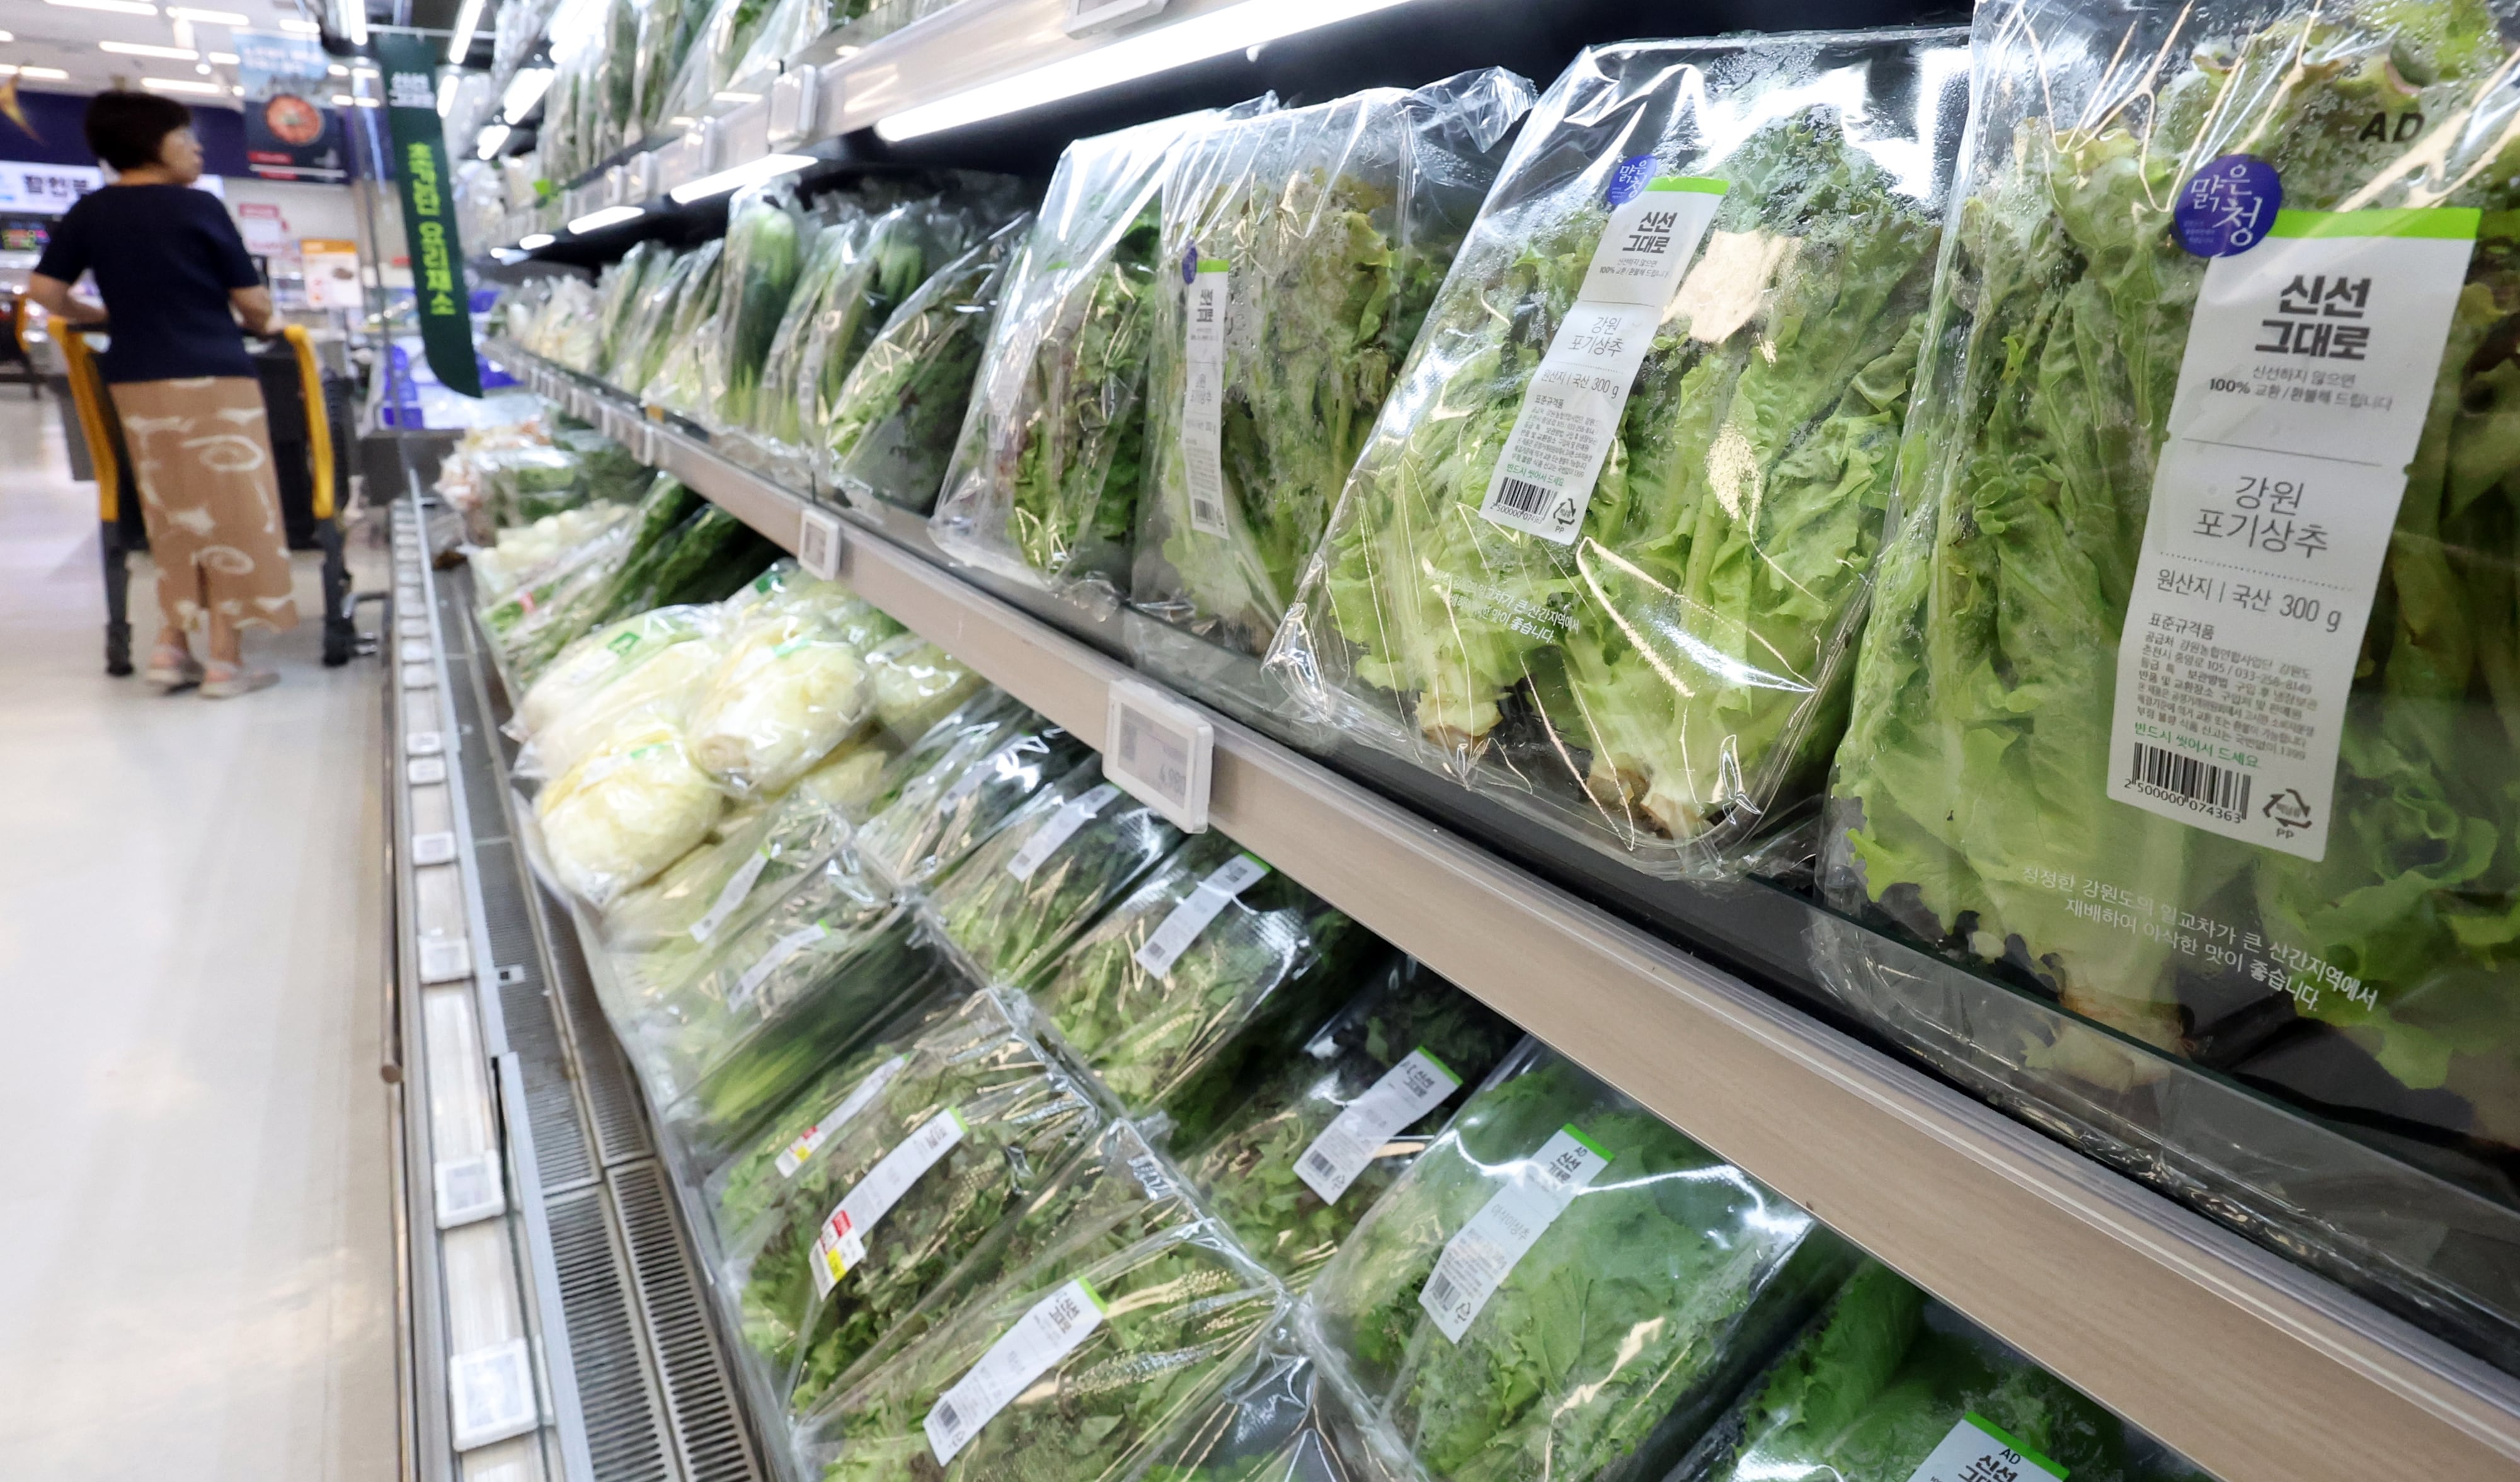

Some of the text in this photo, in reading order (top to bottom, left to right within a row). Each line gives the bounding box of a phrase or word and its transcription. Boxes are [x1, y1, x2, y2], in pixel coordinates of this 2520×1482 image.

[2359, 112, 2425, 142] AD
[2191, 164, 2253, 212] 맑은
[1637, 212, 1678, 233] 신선
[2213, 196, 2263, 247] 청
[1622, 234, 1671, 254] 그대로
[2278, 274, 2372, 319] 신선
[1591, 316, 1622, 335] 강원
[2254, 319, 2371, 361] 그대로
[1567, 335, 1624, 357] 포기상추
[1541, 369, 1566, 385] 원산지
[1572, 373, 1591, 389] 국산
[1591, 377, 1611, 393] 300
[1612, 385, 1620, 399] g
[2253, 365, 2356, 388] 신선하지 않으면
[2209, 377, 2251, 394] 100%
[2334, 391, 2393, 411] 드립니다
[1506, 463, 1527, 477] 반드시
[1528, 469, 1547, 483] 씻어서
[2235, 476, 2305, 517] 강원
[1555, 525, 1565, 534] PP
[2192, 508, 2328, 559] 포기상추
[2157, 568, 2213, 600] 원산지
[2232, 583, 2272, 612] 국산
[2279, 594, 2320, 623] 300
[2326, 609, 2342, 633] g
[1491, 609, 1511, 626] 맛이
[1514, 599, 1529, 614] 큰
[1527, 604, 1580, 635] 산간지역에서
[2148, 612, 2215, 641] 표준규격품
[2145, 631, 2174, 647] 공급처
[2208, 660, 2225, 673] 105
[2134, 721, 2259, 767] 반드시 씻어서 드세요
[2276, 827, 2294, 839] PP
[2065, 898, 2137, 934] 재배하여
[2204, 943, 2244, 973] 맛이
[2248, 958, 2320, 1012] 좋습니다.
[2082, 879, 2154, 917] 강원도의
[2160, 904, 2237, 945] 일교차가
[2242, 931, 2262, 954] 큰
[2269, 941, 2379, 1012] 산간지역에서
[1555, 1151, 1582, 1173] 신선
[1975, 1454, 2019, 1482] 신선
[1998, 1448, 2021, 1465] AD
